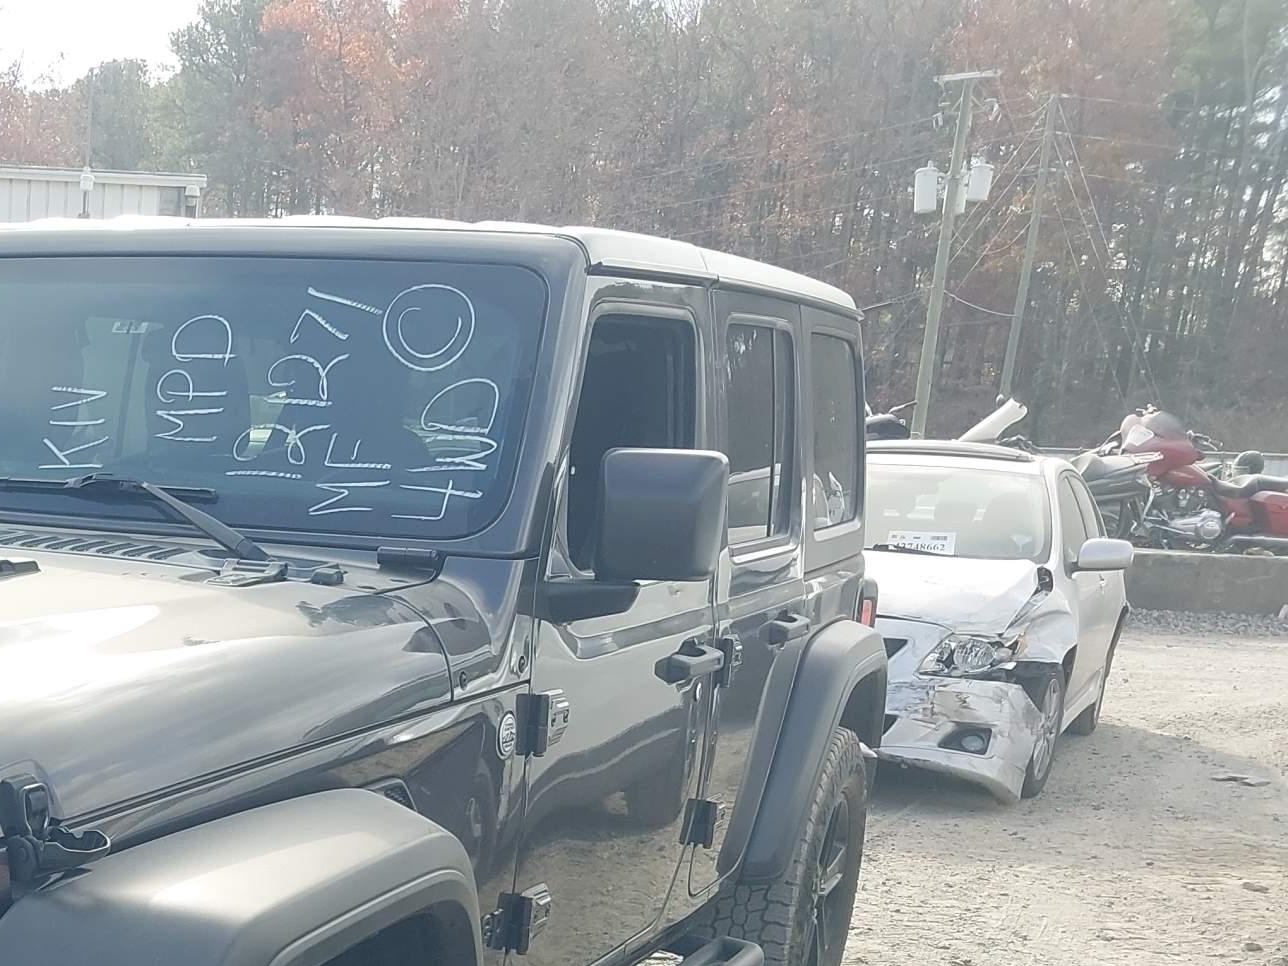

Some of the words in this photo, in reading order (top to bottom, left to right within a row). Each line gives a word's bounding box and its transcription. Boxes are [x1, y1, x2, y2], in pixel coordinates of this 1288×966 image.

[154, 314, 238, 442] MPD
[308, 432, 393, 516] MF
[390, 377, 500, 521] 4WD
